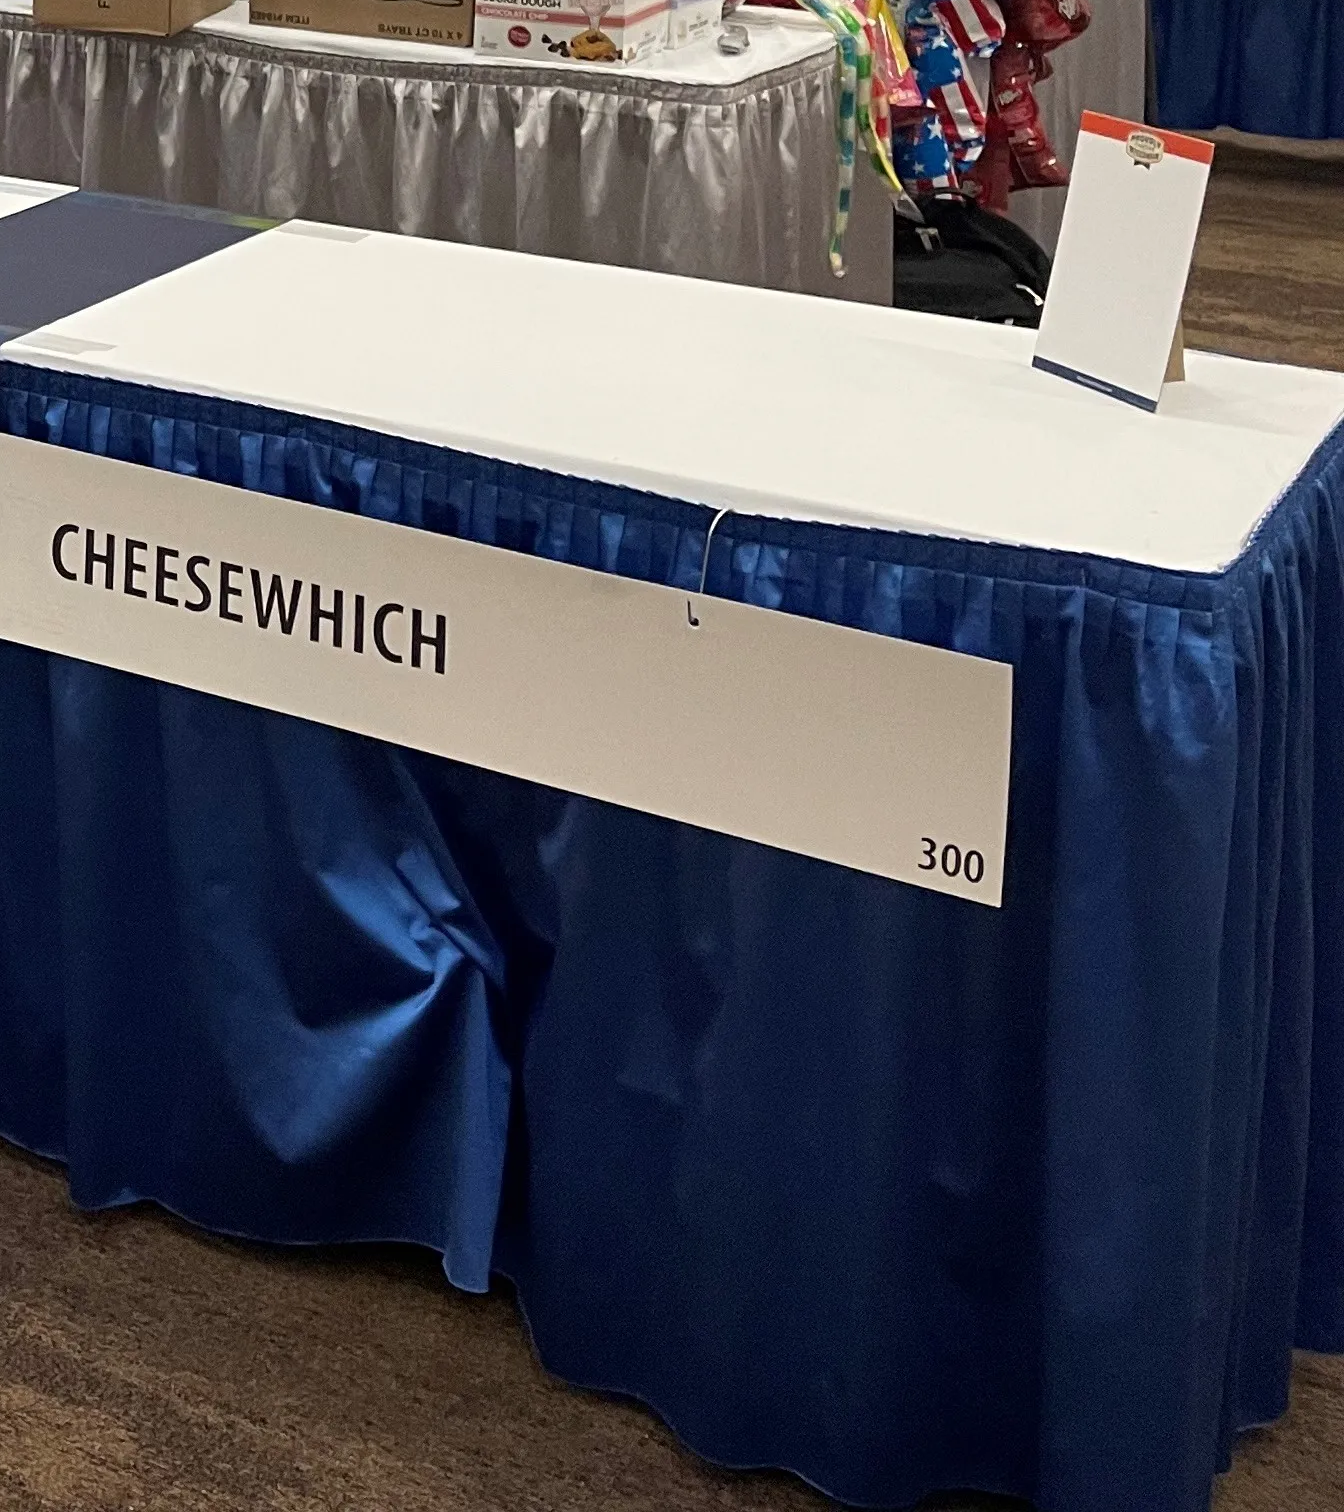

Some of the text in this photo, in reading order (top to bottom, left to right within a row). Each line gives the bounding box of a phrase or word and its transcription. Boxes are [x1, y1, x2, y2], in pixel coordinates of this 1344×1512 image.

[285, 15, 310, 24] ITEM
[480, 7, 548, 20] CHOCOLATE CHIP
[377, 23, 462, 40] 4 X 10 CT TRAYS
[50, 523, 447, 676] CHEESEWHICH
[917, 837, 985, 884] 300
